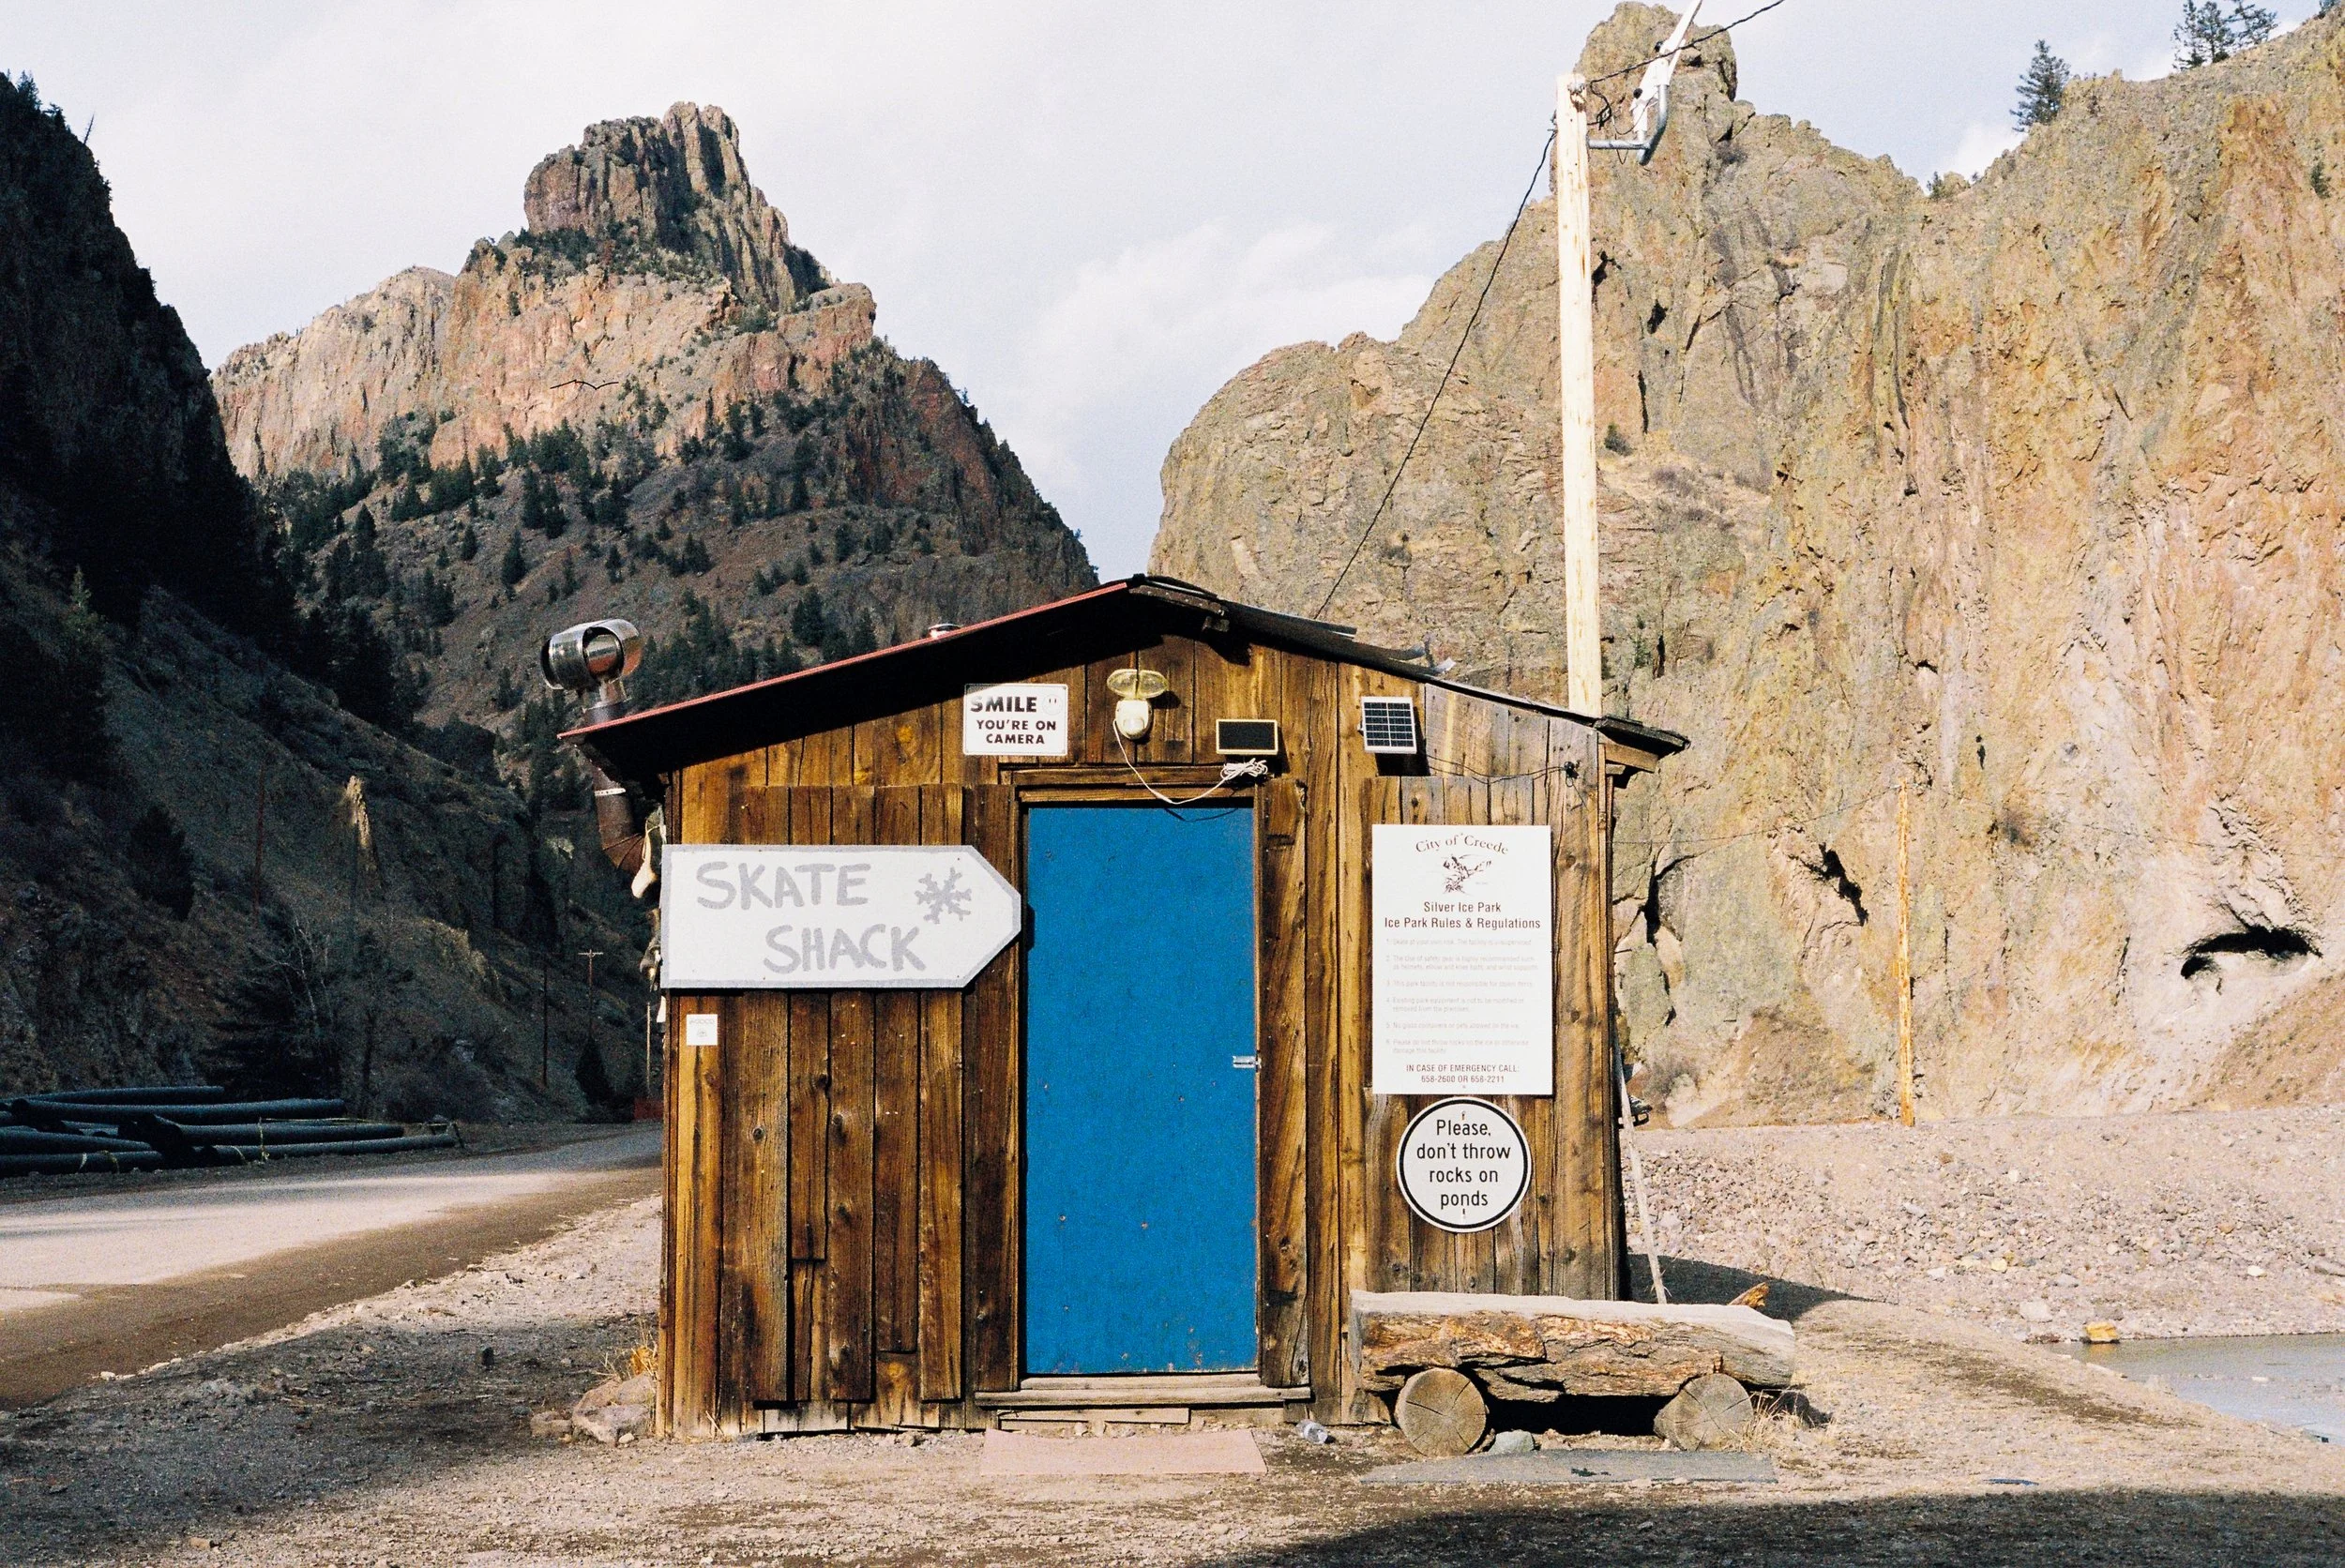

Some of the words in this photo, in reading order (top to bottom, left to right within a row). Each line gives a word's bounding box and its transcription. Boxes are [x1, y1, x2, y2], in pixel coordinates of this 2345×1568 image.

[970, 695, 1037, 713] SMILE
[976, 719, 1029, 731] YOU'RE
[1036, 720, 1057, 731] ON
[986, 733, 1046, 745] CAMERA
[1415, 838, 1441, 852] City
[1445, 834, 1459, 846] of
[1463, 835, 1509, 855] Creede
[695, 860, 872, 911] SKATE
[1423, 901, 1455, 912] Silver
[1458, 901, 1474, 912] Ice
[1477, 901, 1502, 913] Park
[1384, 917, 1400, 928] Ice
[1403, 917, 1428, 928] Park
[1431, 917, 1461, 928] Rules
[1465, 918, 1474, 928] &
[1476, 917, 1541, 931] Regulations
[763, 923, 928, 975] SHACK
[1406, 1064, 1415, 1073] IN
[1416, 1064, 1435, 1073] CASE
[1438, 1064, 1448, 1073] OF
[1450, 1064, 1496, 1073] EMERGENCY
[1458, 1075, 1469, 1083] OR
[1436, 1119, 1491, 1137] Please,
[1416, 1143, 1457, 1159] don't
[1462, 1143, 1511, 1159] throw
[1429, 1167, 1473, 1183] rocks
[1478, 1170, 1499, 1183] on
[1440, 1190, 1489, 1210] ponds
